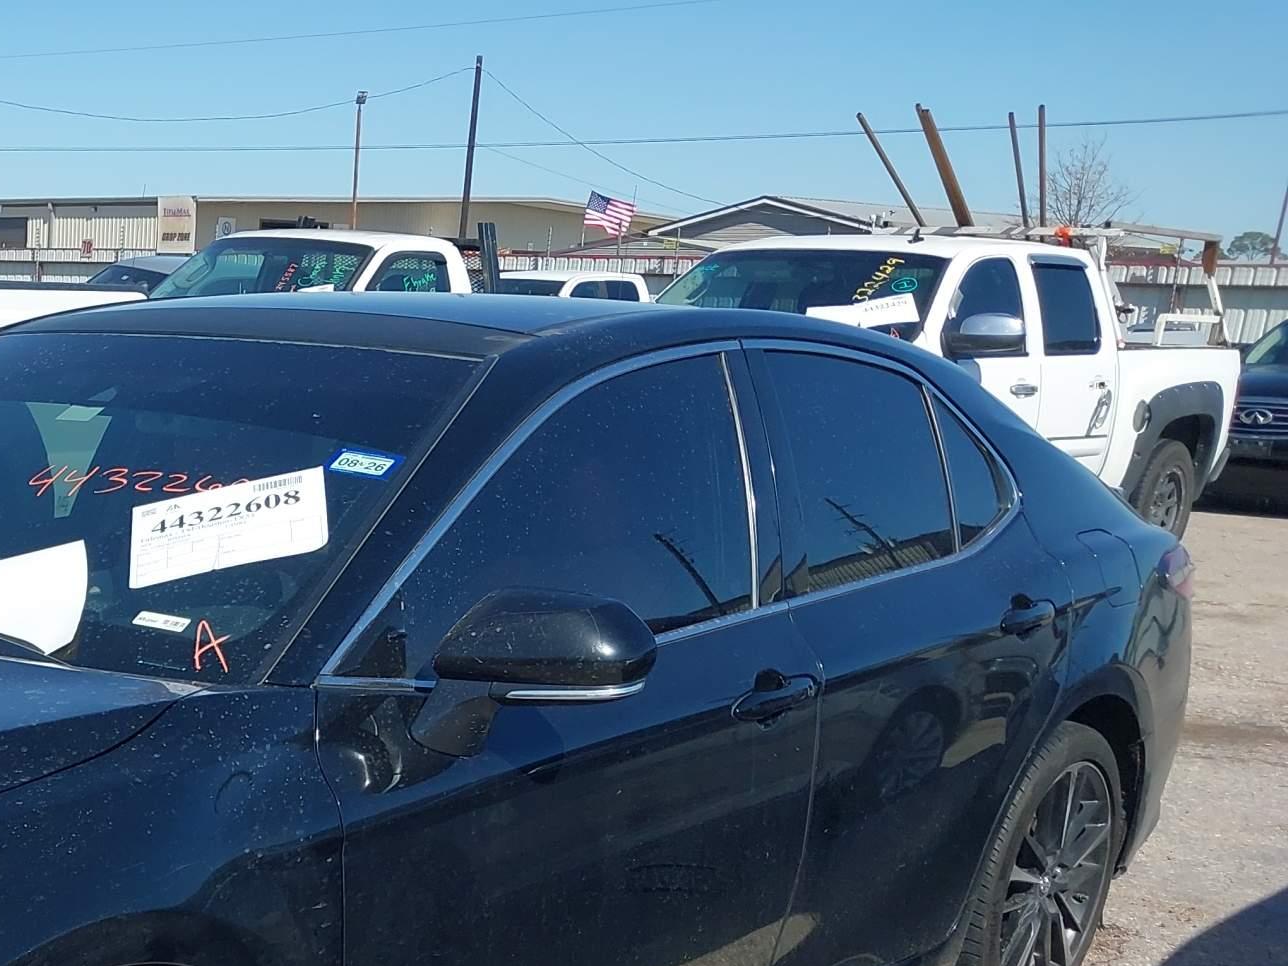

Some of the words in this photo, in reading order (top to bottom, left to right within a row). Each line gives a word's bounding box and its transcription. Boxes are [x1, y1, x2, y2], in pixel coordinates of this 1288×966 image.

[337, 457, 360, 468] 08
[363, 461, 387, 472] 26
[151, 489, 301, 534] 44322608
[193, 619, 232, 673] A
